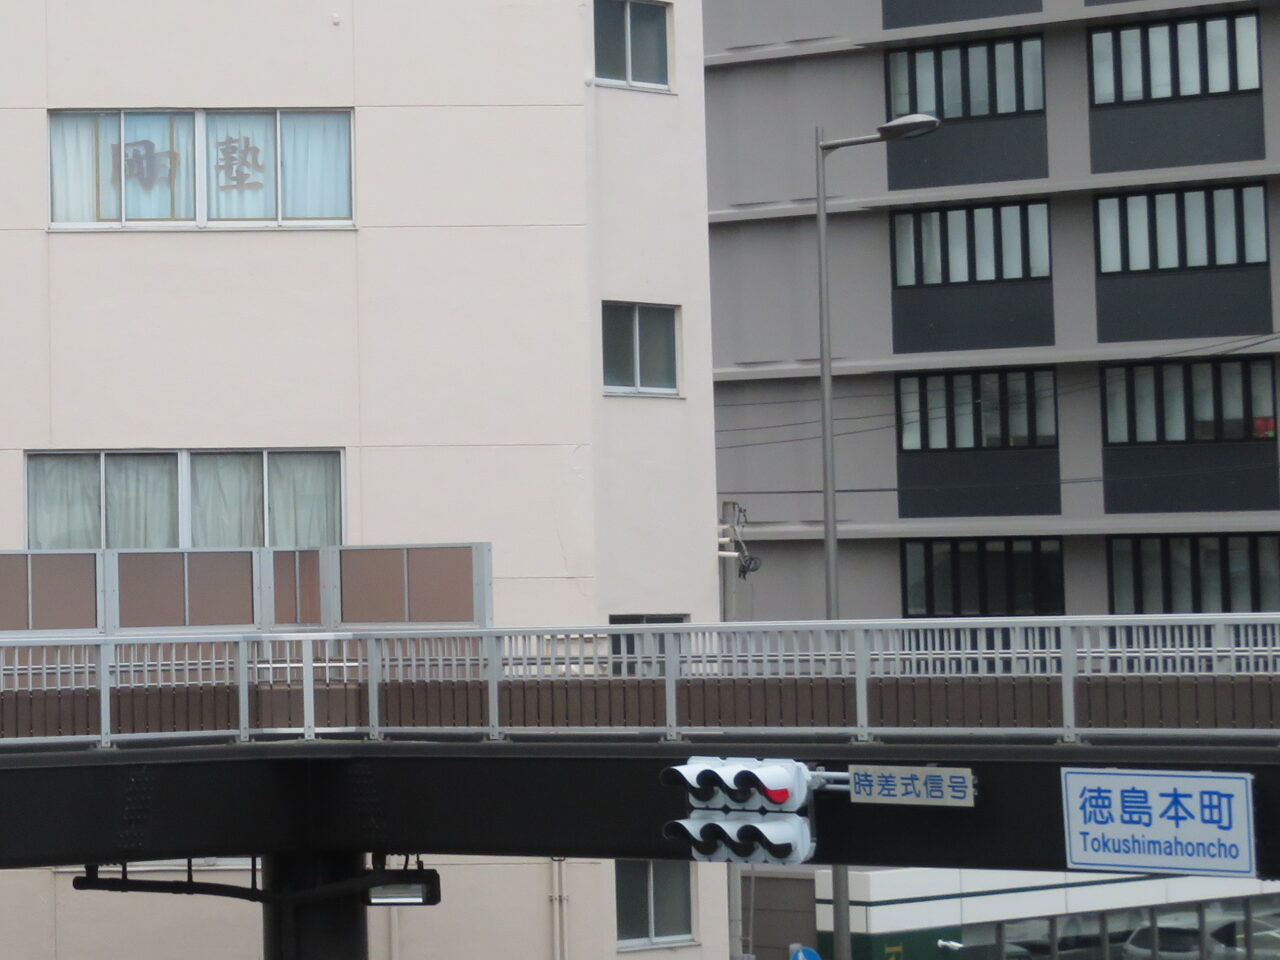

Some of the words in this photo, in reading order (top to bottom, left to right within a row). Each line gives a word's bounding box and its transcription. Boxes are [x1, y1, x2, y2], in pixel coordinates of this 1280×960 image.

[853, 772, 968, 800] 時差式信号
[1079, 786, 1235, 831] 徳島本町
[1079, 831, 1240, 860] Tokushimahoncho
